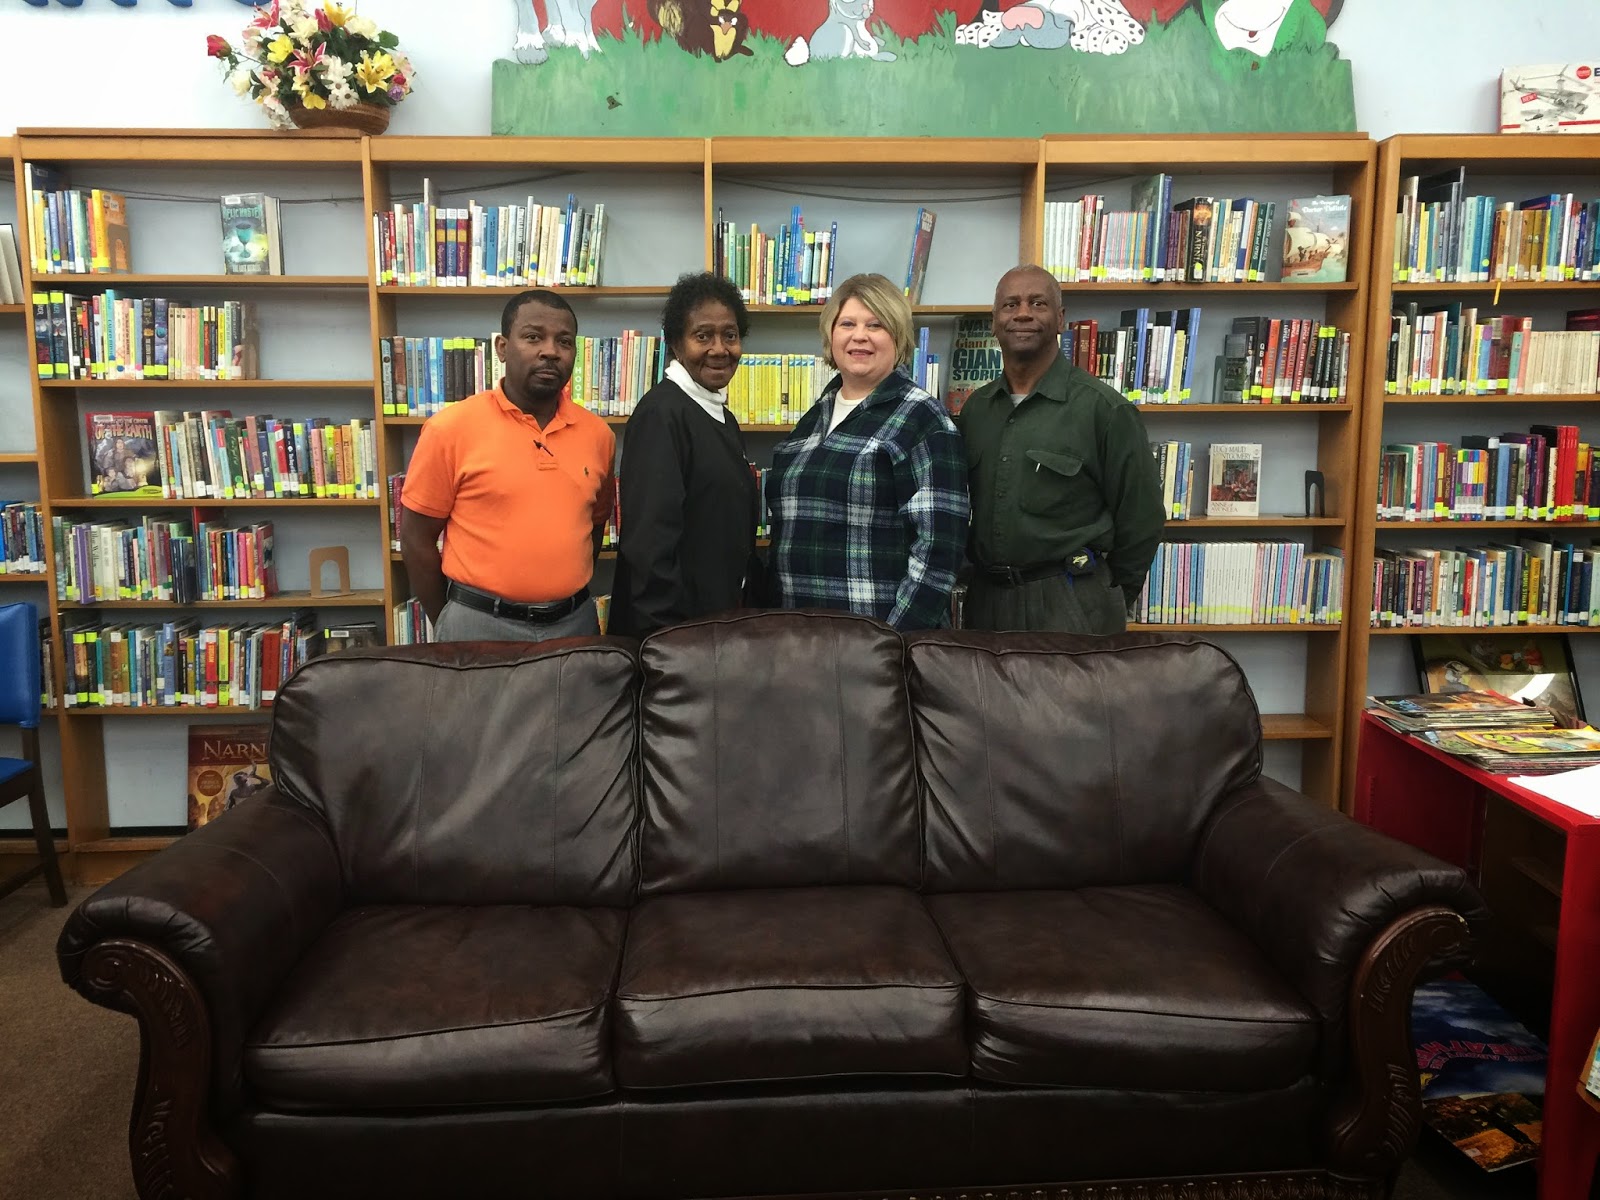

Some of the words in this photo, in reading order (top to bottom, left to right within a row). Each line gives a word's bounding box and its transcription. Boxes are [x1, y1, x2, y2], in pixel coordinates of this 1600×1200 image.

[956, 337, 988, 349] Giant
[953, 348, 1001, 369] GIAN
[952, 370, 1002, 381] STORIE
[125, 422, 152, 440] EARTH
[201, 740, 269, 761] NARN
